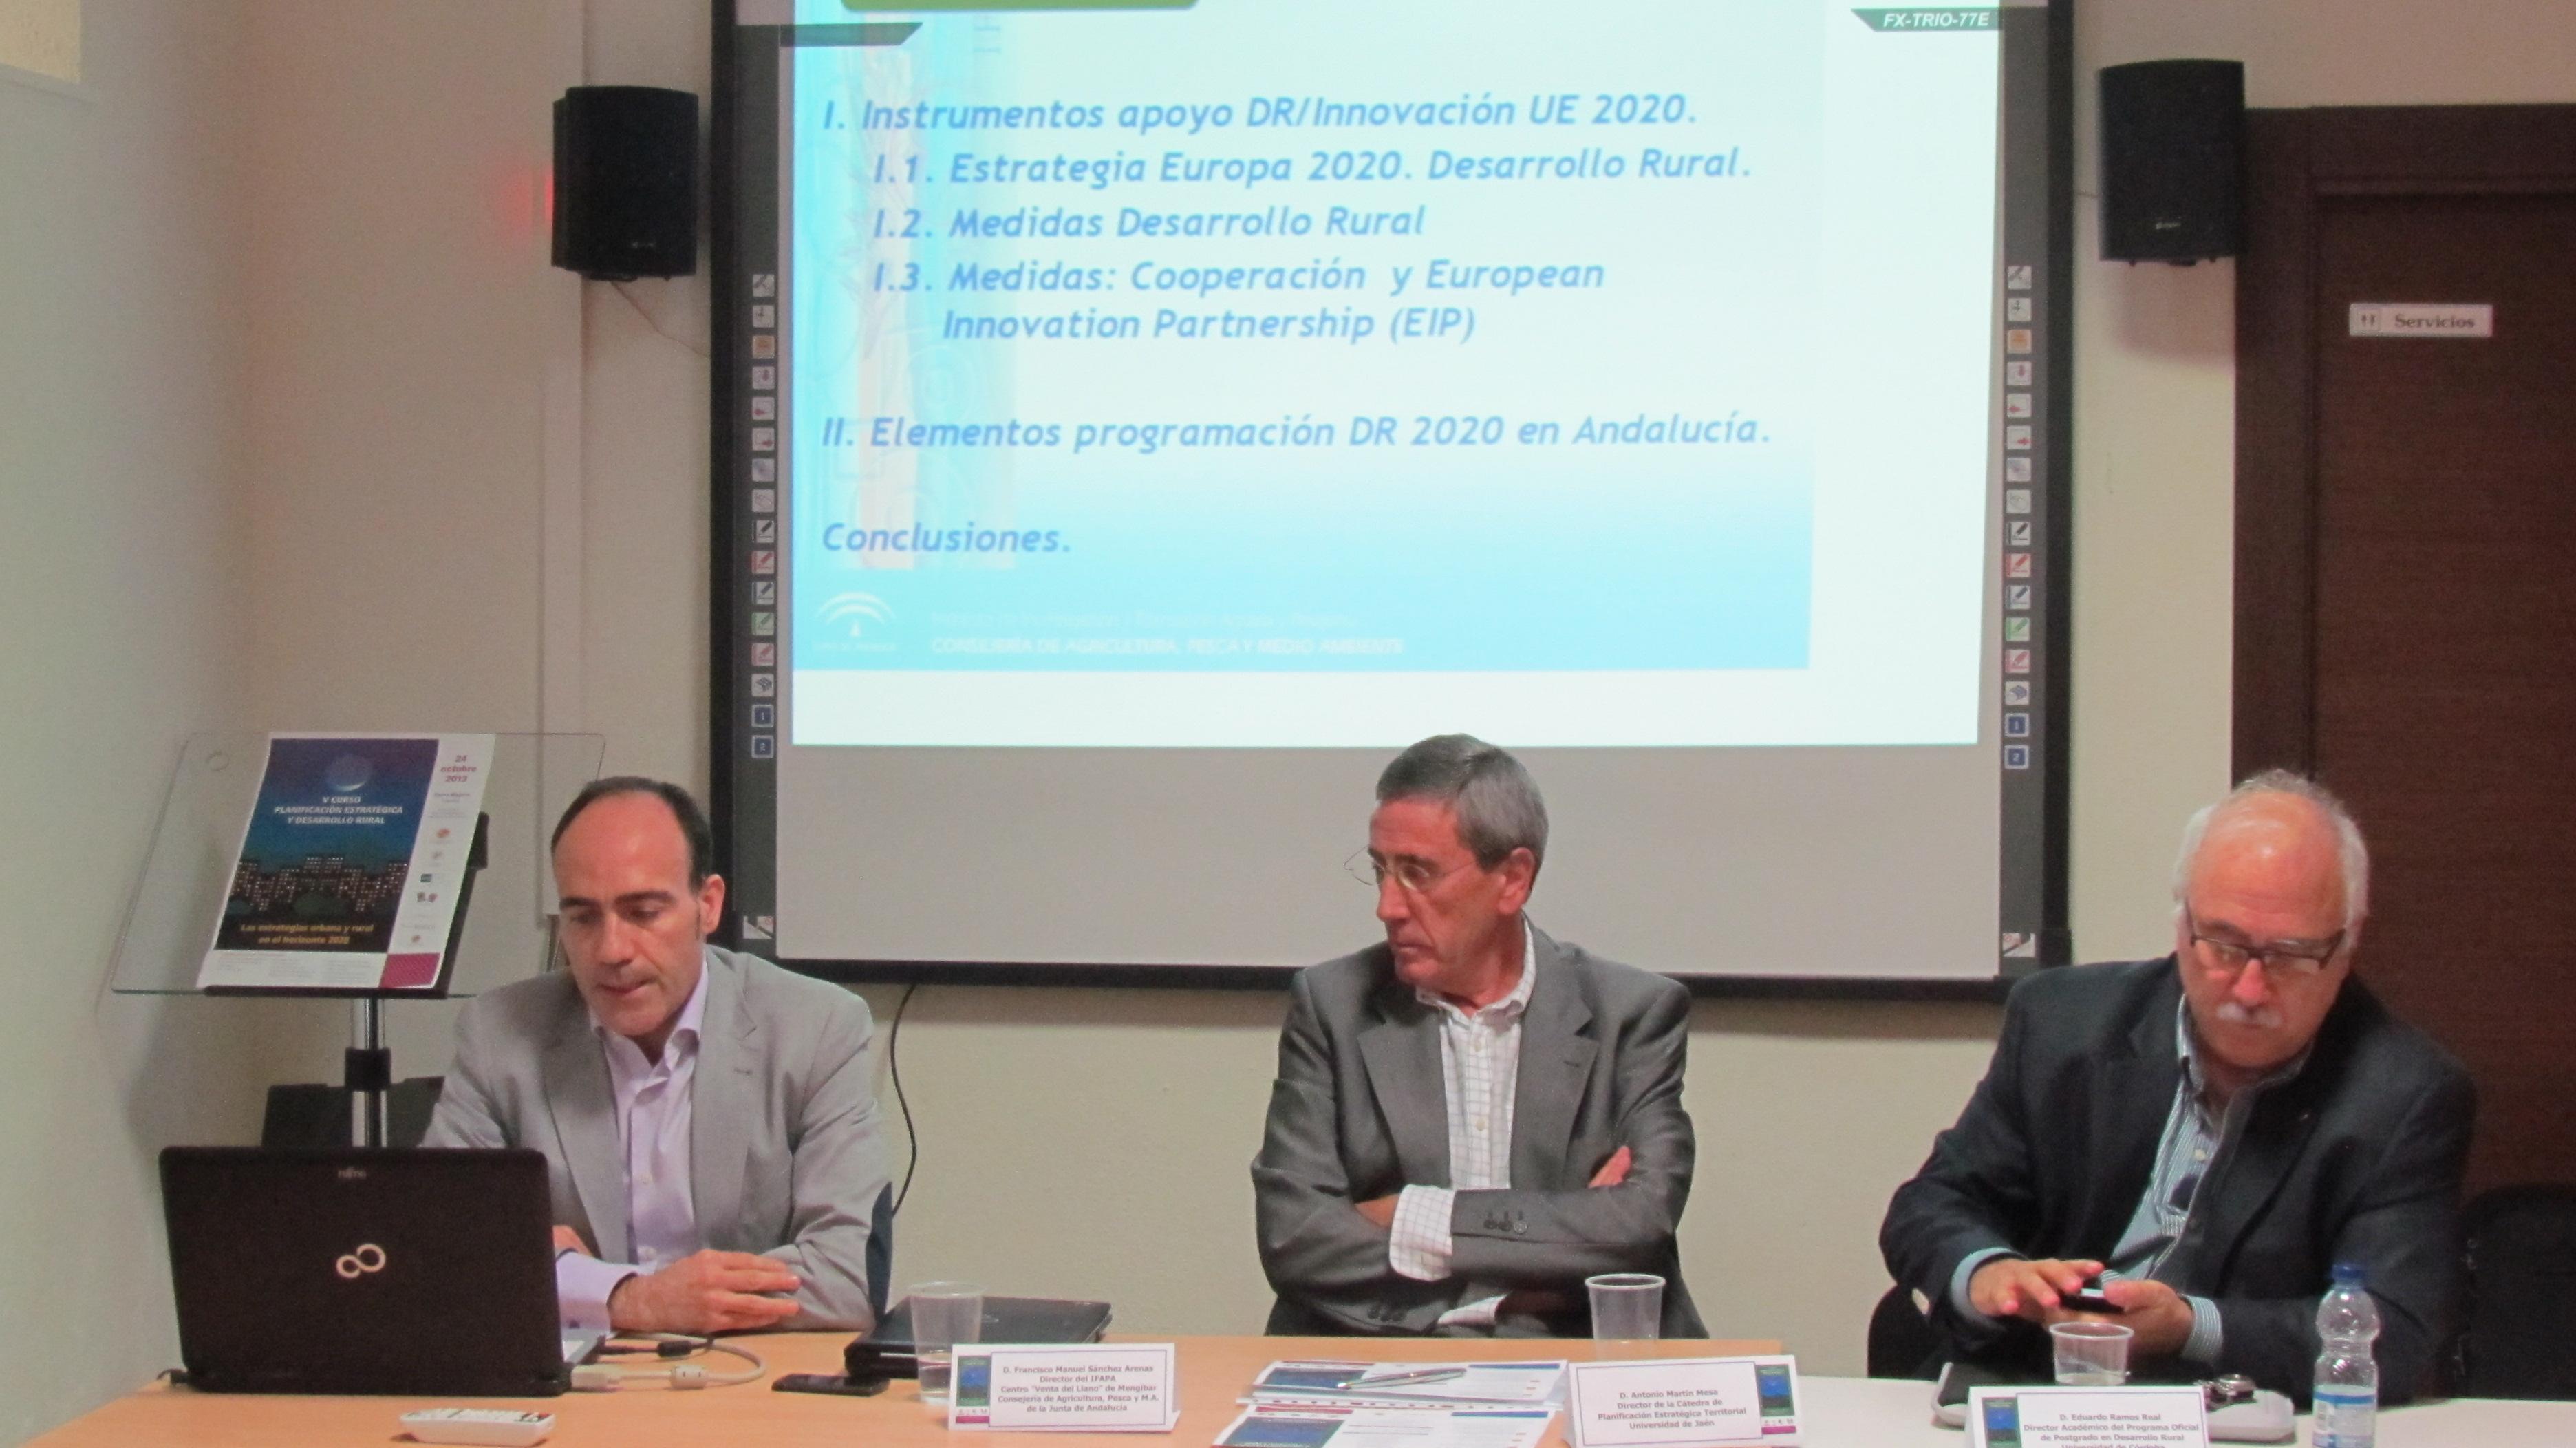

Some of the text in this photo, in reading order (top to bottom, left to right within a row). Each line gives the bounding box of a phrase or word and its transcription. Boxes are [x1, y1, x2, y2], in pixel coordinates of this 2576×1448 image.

[1883, 12, 1990, 28] FX-TRIO-77E
[823, 92, 1696, 136] I. Instrumentos apoyo DR/Innovación UE 2020.
[874, 146, 1750, 191] I.1. Estrategia Europa 2020. Desarrollo Rural.
[874, 204, 1427, 239] I.2. Medidas Desarrollo Rural
[872, 257, 1605, 298] I.3. Medidas: Cooperación y European
[943, 306, 1476, 345] Innovation Partnership (EIP)
[2394, 313, 2475, 328] Servicios
[822, 410, 1770, 455] II. Elementos programación DR 2020 en Andalucía.
[823, 521, 1071, 552] Conclusiones.
[330, 796, 362, 804] CURSO
[274, 805, 403, 814] PLANIFICACIÓN ESTRATÉGICA
[288, 816, 385, 824] Y DESARROLLO RURAL
[241, 924, 255, 932] Las
[257, 924, 309, 933] estrategias
[343, 926, 350, 934] y
[351, 924, 374, 932] rural
[271, 936, 282, 944] el
[283, 936, 327, 944] horizonte
[1055, 1365, 1086, 1373] Manuel
[1056, 1394, 1105, 1403] Agricultura,
[1617, 1402, 1652, 1410] Director
[1676, 1398, 1710, 1407] Cátedra
[1598, 1407, 1747, 1420] Planificación Estratégica Territorial
[2071, 1413, 2108, 1421] Eduardo
[1629, 1420, 1680, 1430] Universidad
[1695, 1419, 1715, 1427] Jaén
[2061, 1423, 2109, 1431] Académico
[2126, 1423, 2169, 1432] Programa
[2053, 1434, 2099, 1442] Postgrado
[2160, 1433, 2185, 1441] Rural
